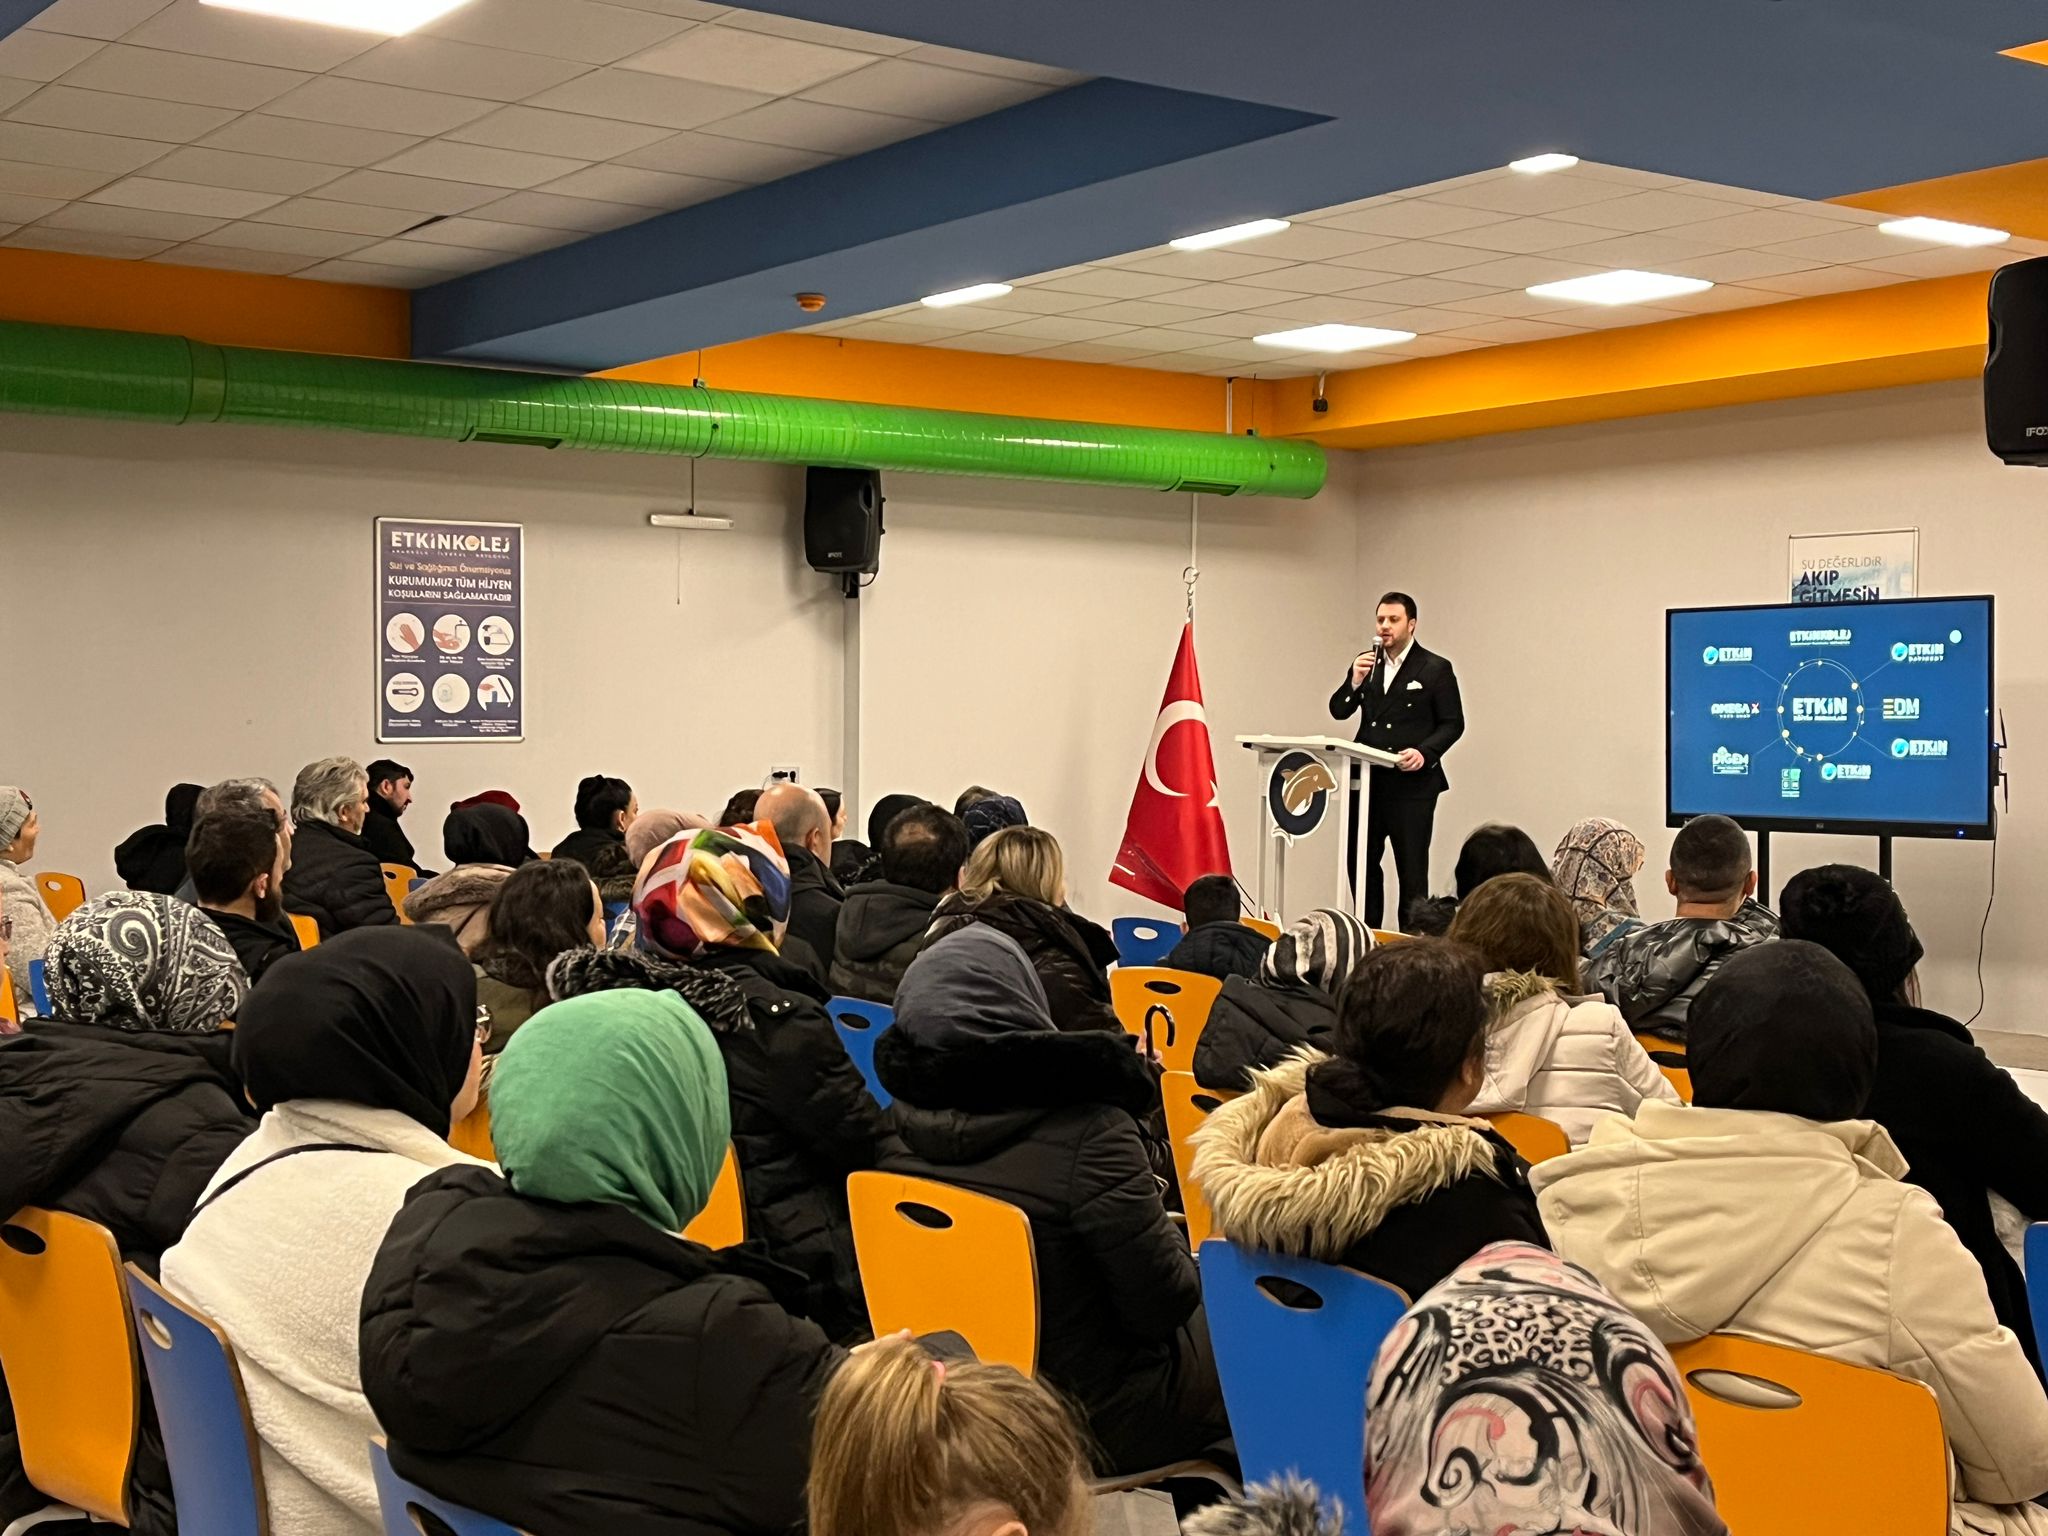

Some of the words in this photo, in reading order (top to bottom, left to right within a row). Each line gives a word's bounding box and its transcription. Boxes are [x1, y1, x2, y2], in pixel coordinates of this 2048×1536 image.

[1802, 560, 1815, 570] SU
[388, 575, 453, 588] KURUMUMUZ
[455, 576, 476, 589] TÜM
[478, 577, 512, 590] HİJYEN
[1800, 570, 1839, 586] AKIP
[388, 589, 441, 599] KOŞULLARINI
[443, 590, 512, 602] SAĞLAMAKTADIR
